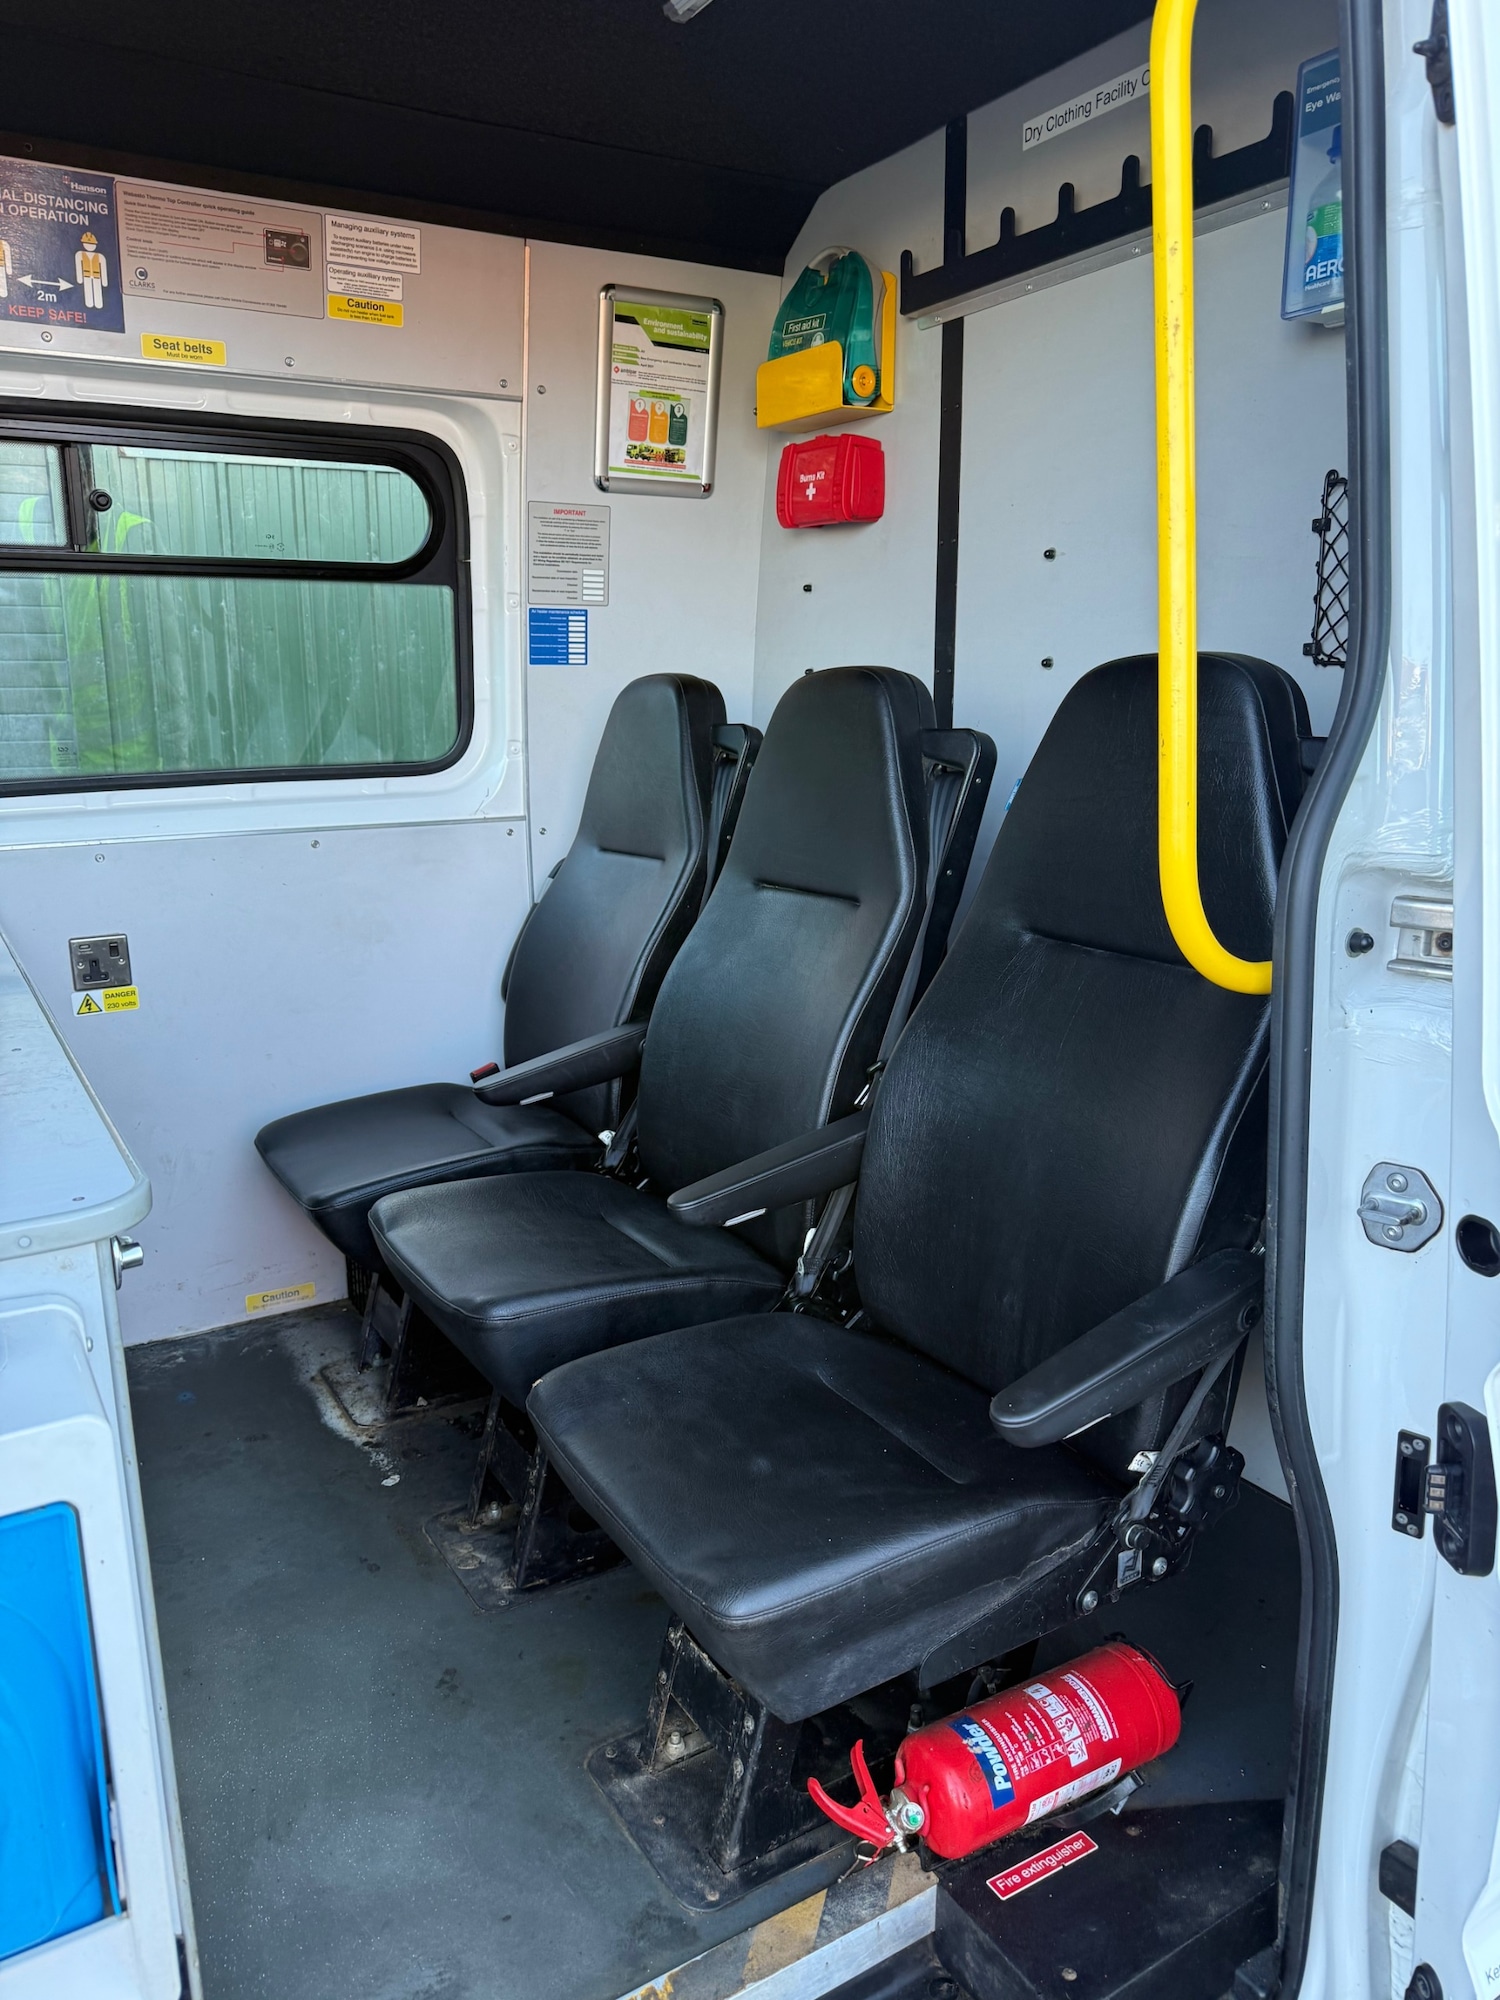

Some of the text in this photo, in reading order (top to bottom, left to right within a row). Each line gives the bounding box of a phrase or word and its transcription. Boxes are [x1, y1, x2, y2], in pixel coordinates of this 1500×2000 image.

[1025, 125, 1043, 143] Dry
[1046, 102, 1091, 132] Clothing
[1096, 78, 1138, 109] Facility
[1306, 100, 1323, 112] Eye
[71, 182, 107, 194] Hanson
[24, 192, 108, 215] DISTANCING
[177, 199, 201, 208] Controller
[217, 205, 240, 215] operating
[8, 204, 89, 226] OPERATION
[331, 221, 415, 240] Managing auxiliary systems
[329, 267, 356, 277] Operating
[129, 279, 156, 289] CLARKS
[37, 290, 57, 302] 2m
[347, 298, 385, 311] Caution
[9, 305, 87, 324] KEEP SAFE!
[643, 318, 683, 330] Environment
[788, 323, 801, 332] First
[801, 320, 811, 330] aid
[667, 328, 707, 342] sustainability
[153, 338, 213, 355] Seat belts
[799, 470, 825, 483] Burns Kit
[105, 990, 136, 999] DANGER
[262, 1290, 300, 1303] Caution
[1060, 1674, 1080, 1690] EDGE
[1077, 1690, 1109, 1742] COMMANDER
[962, 1723, 1012, 1791] Powder
[981, 1718, 1020, 1780] FIRE EXTINGUISHER
[996, 1839, 1085, 1890] Fire extinguisher
[1485, 1964, 1500, 1985] Ke
